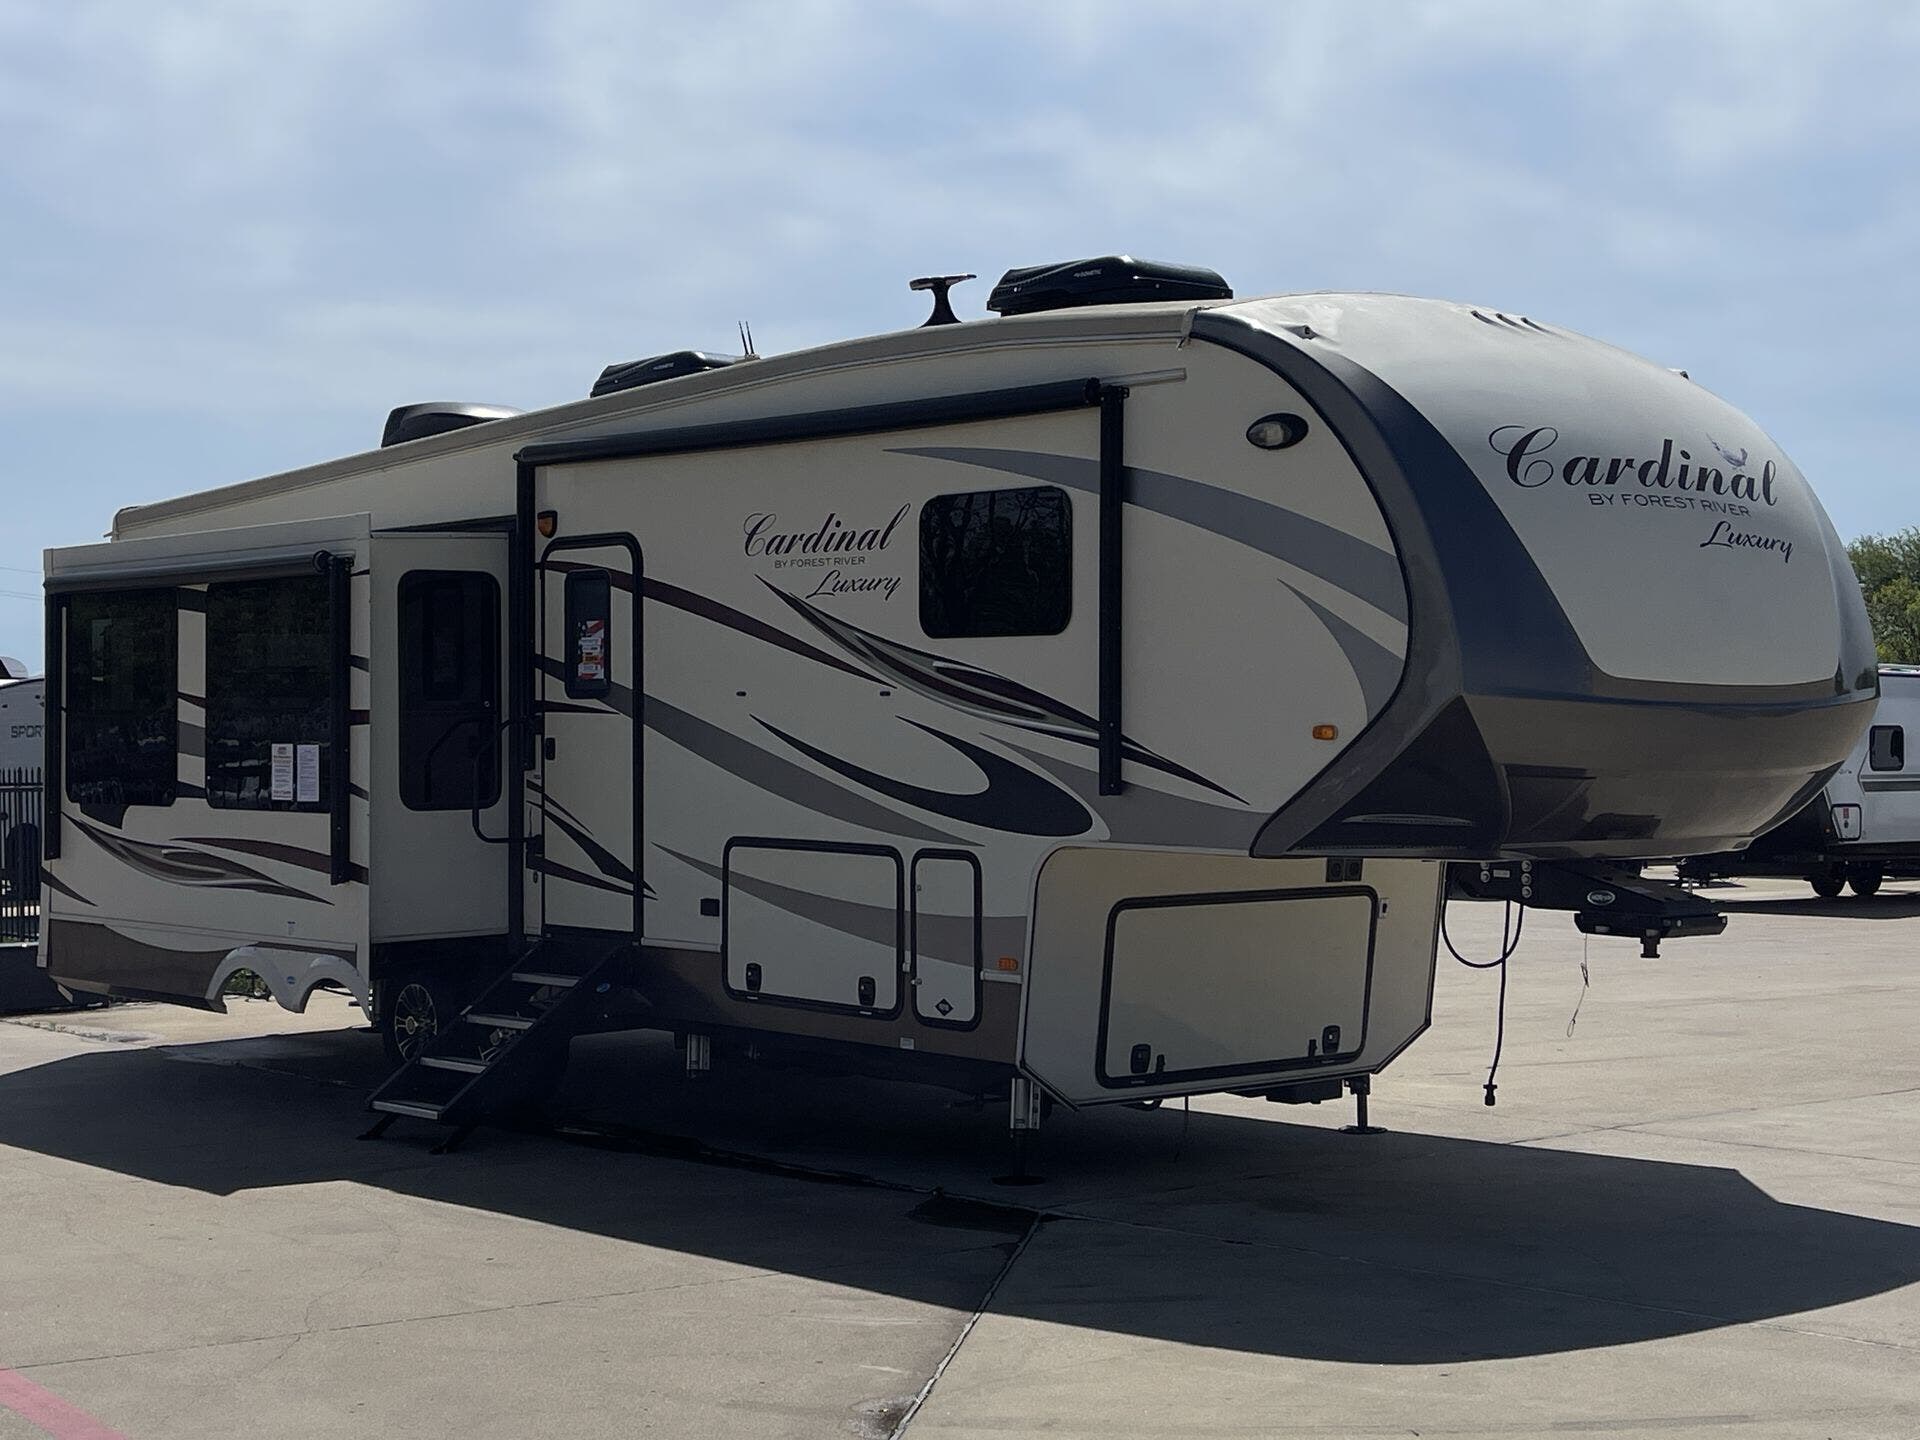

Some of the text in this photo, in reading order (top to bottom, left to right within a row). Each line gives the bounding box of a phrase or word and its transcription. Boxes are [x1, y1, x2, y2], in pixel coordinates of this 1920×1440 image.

[1489, 425, 1777, 506] Cardinal
[1589, 494, 1751, 517] BY FOREST RIVER
[743, 502, 911, 557] Cardinal
[1700, 521, 1793, 563] Luxury
[774, 556, 866, 569] BY FOREST RIVER
[805, 569, 901, 601] Luxury
[11, 725, 44, 738] SPOR
